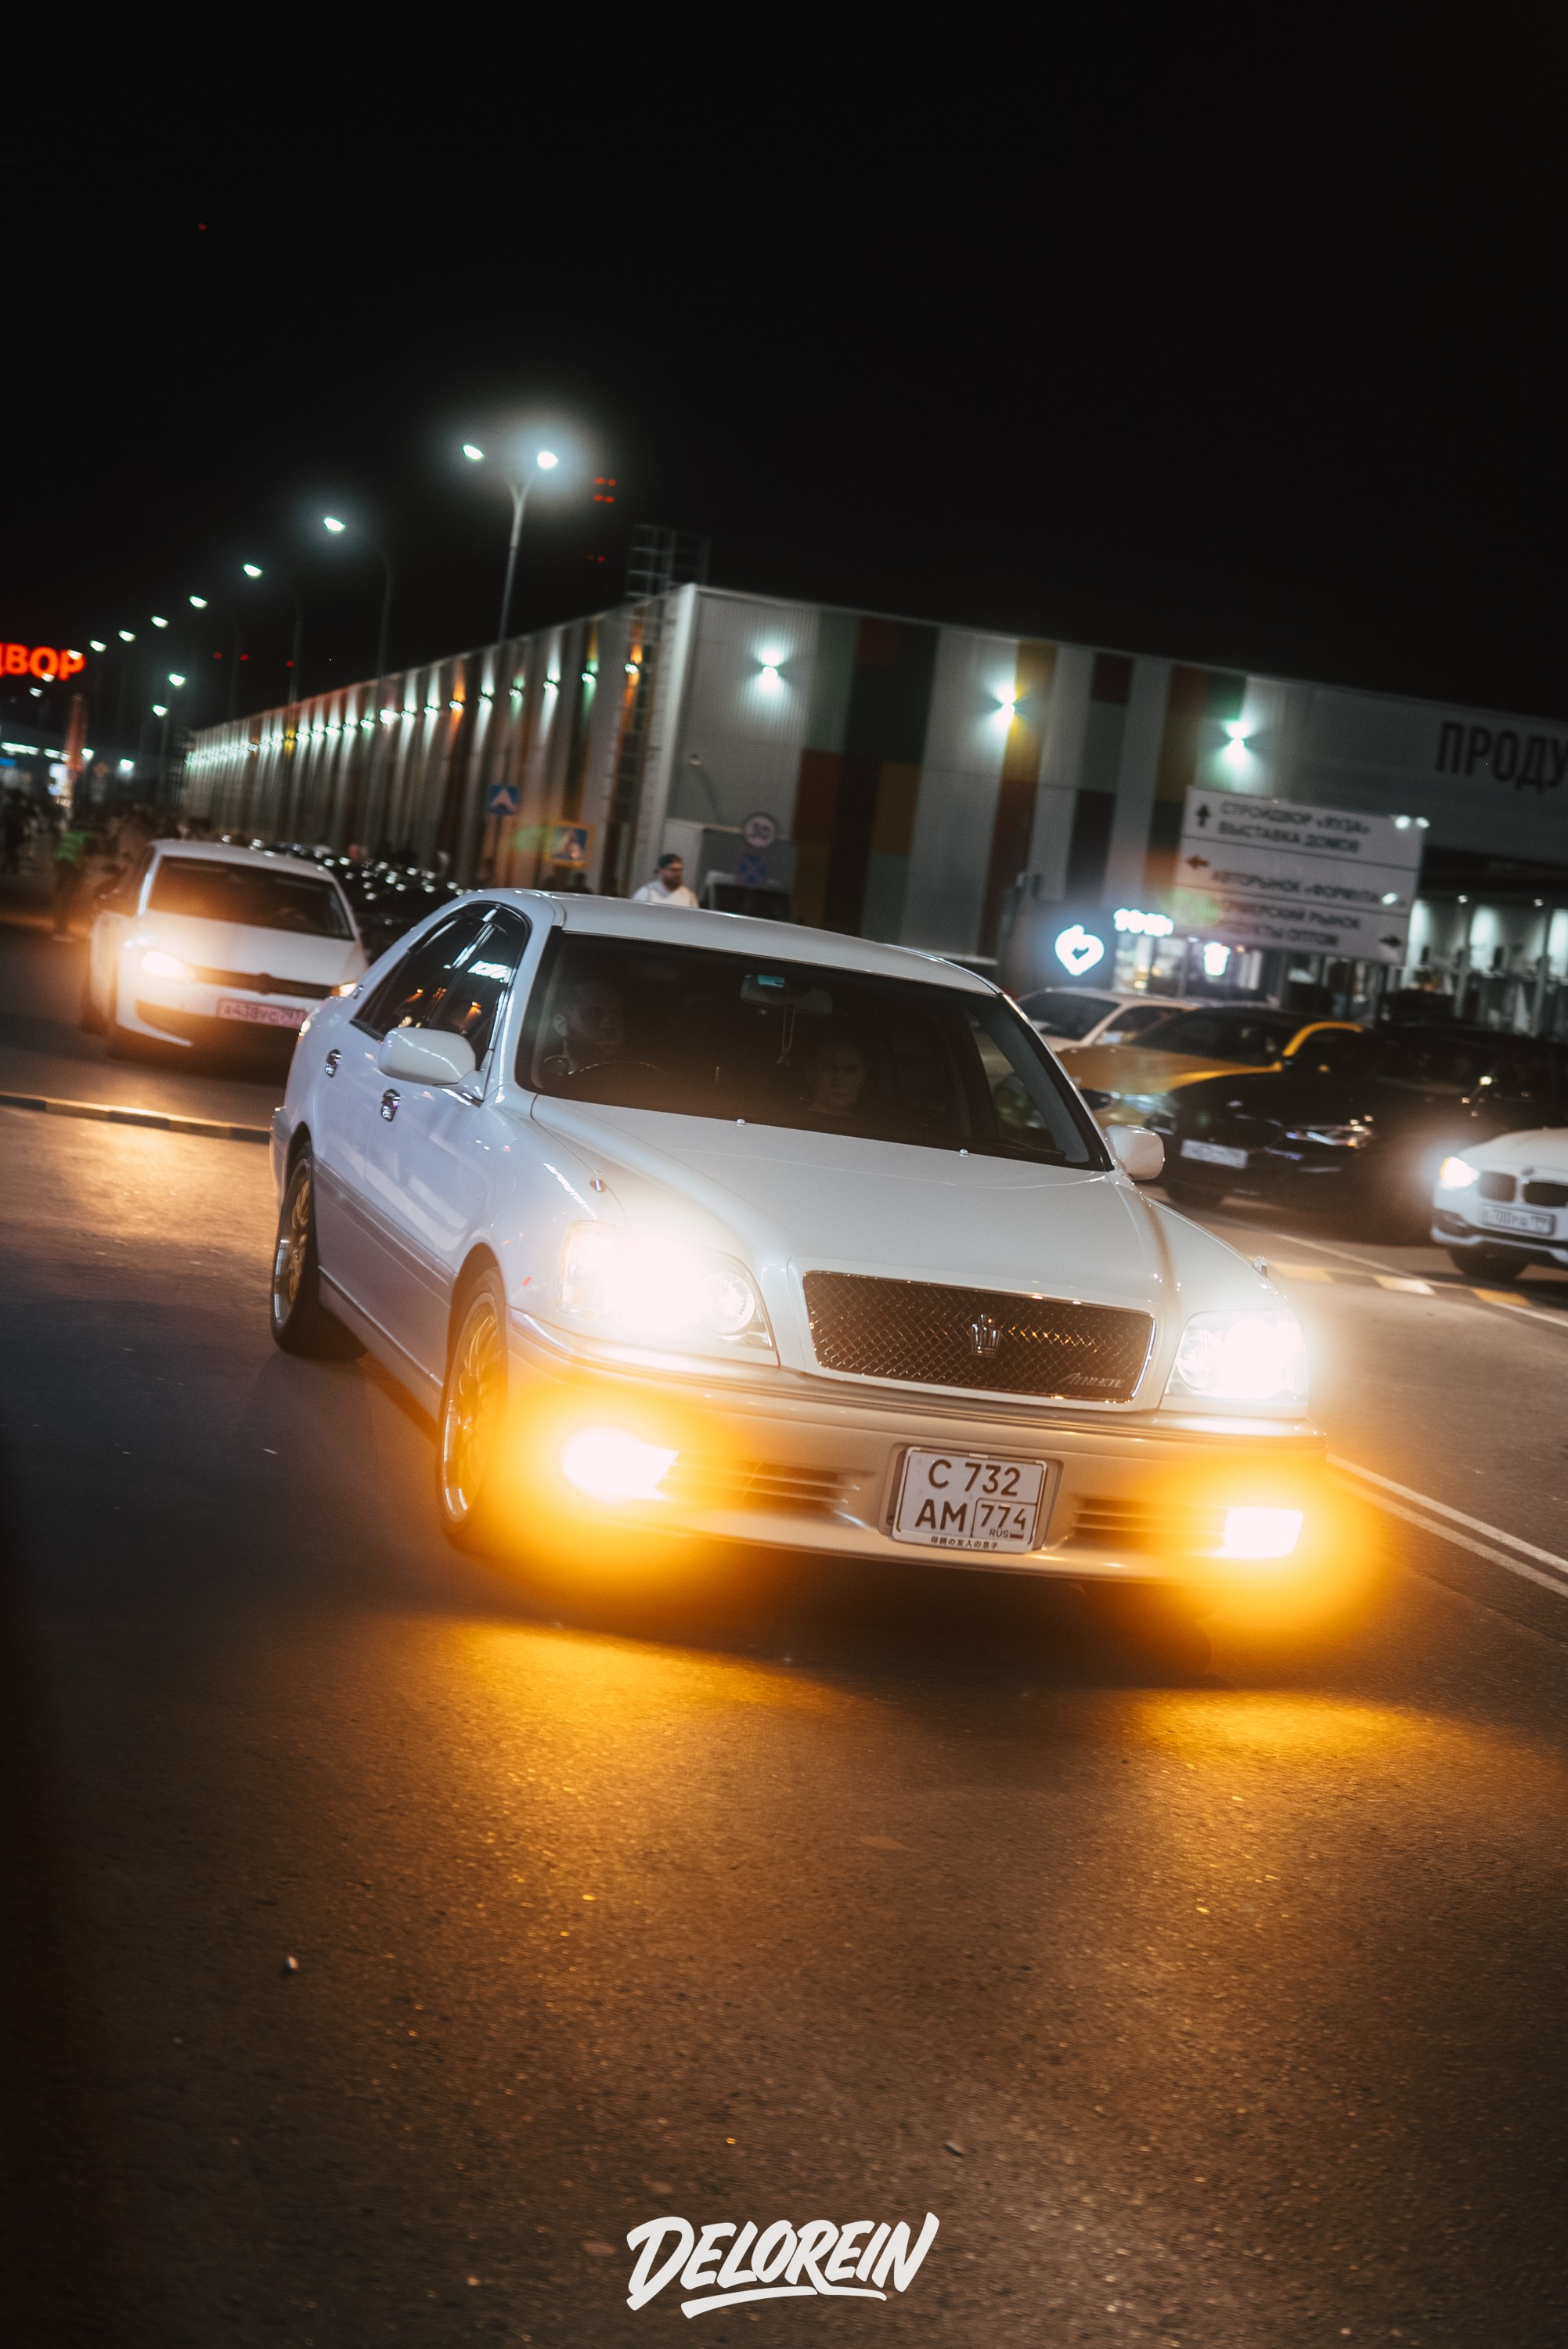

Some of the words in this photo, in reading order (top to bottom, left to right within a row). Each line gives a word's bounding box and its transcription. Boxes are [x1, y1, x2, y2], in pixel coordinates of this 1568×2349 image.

[0, 641, 85, 682] ВОР
[964, 1462, 1021, 1496] 732
[914, 1499, 968, 1532] АМ
[980, 1504, 1026, 1530] 774
[989, 1528, 1009, 1539] RUS
